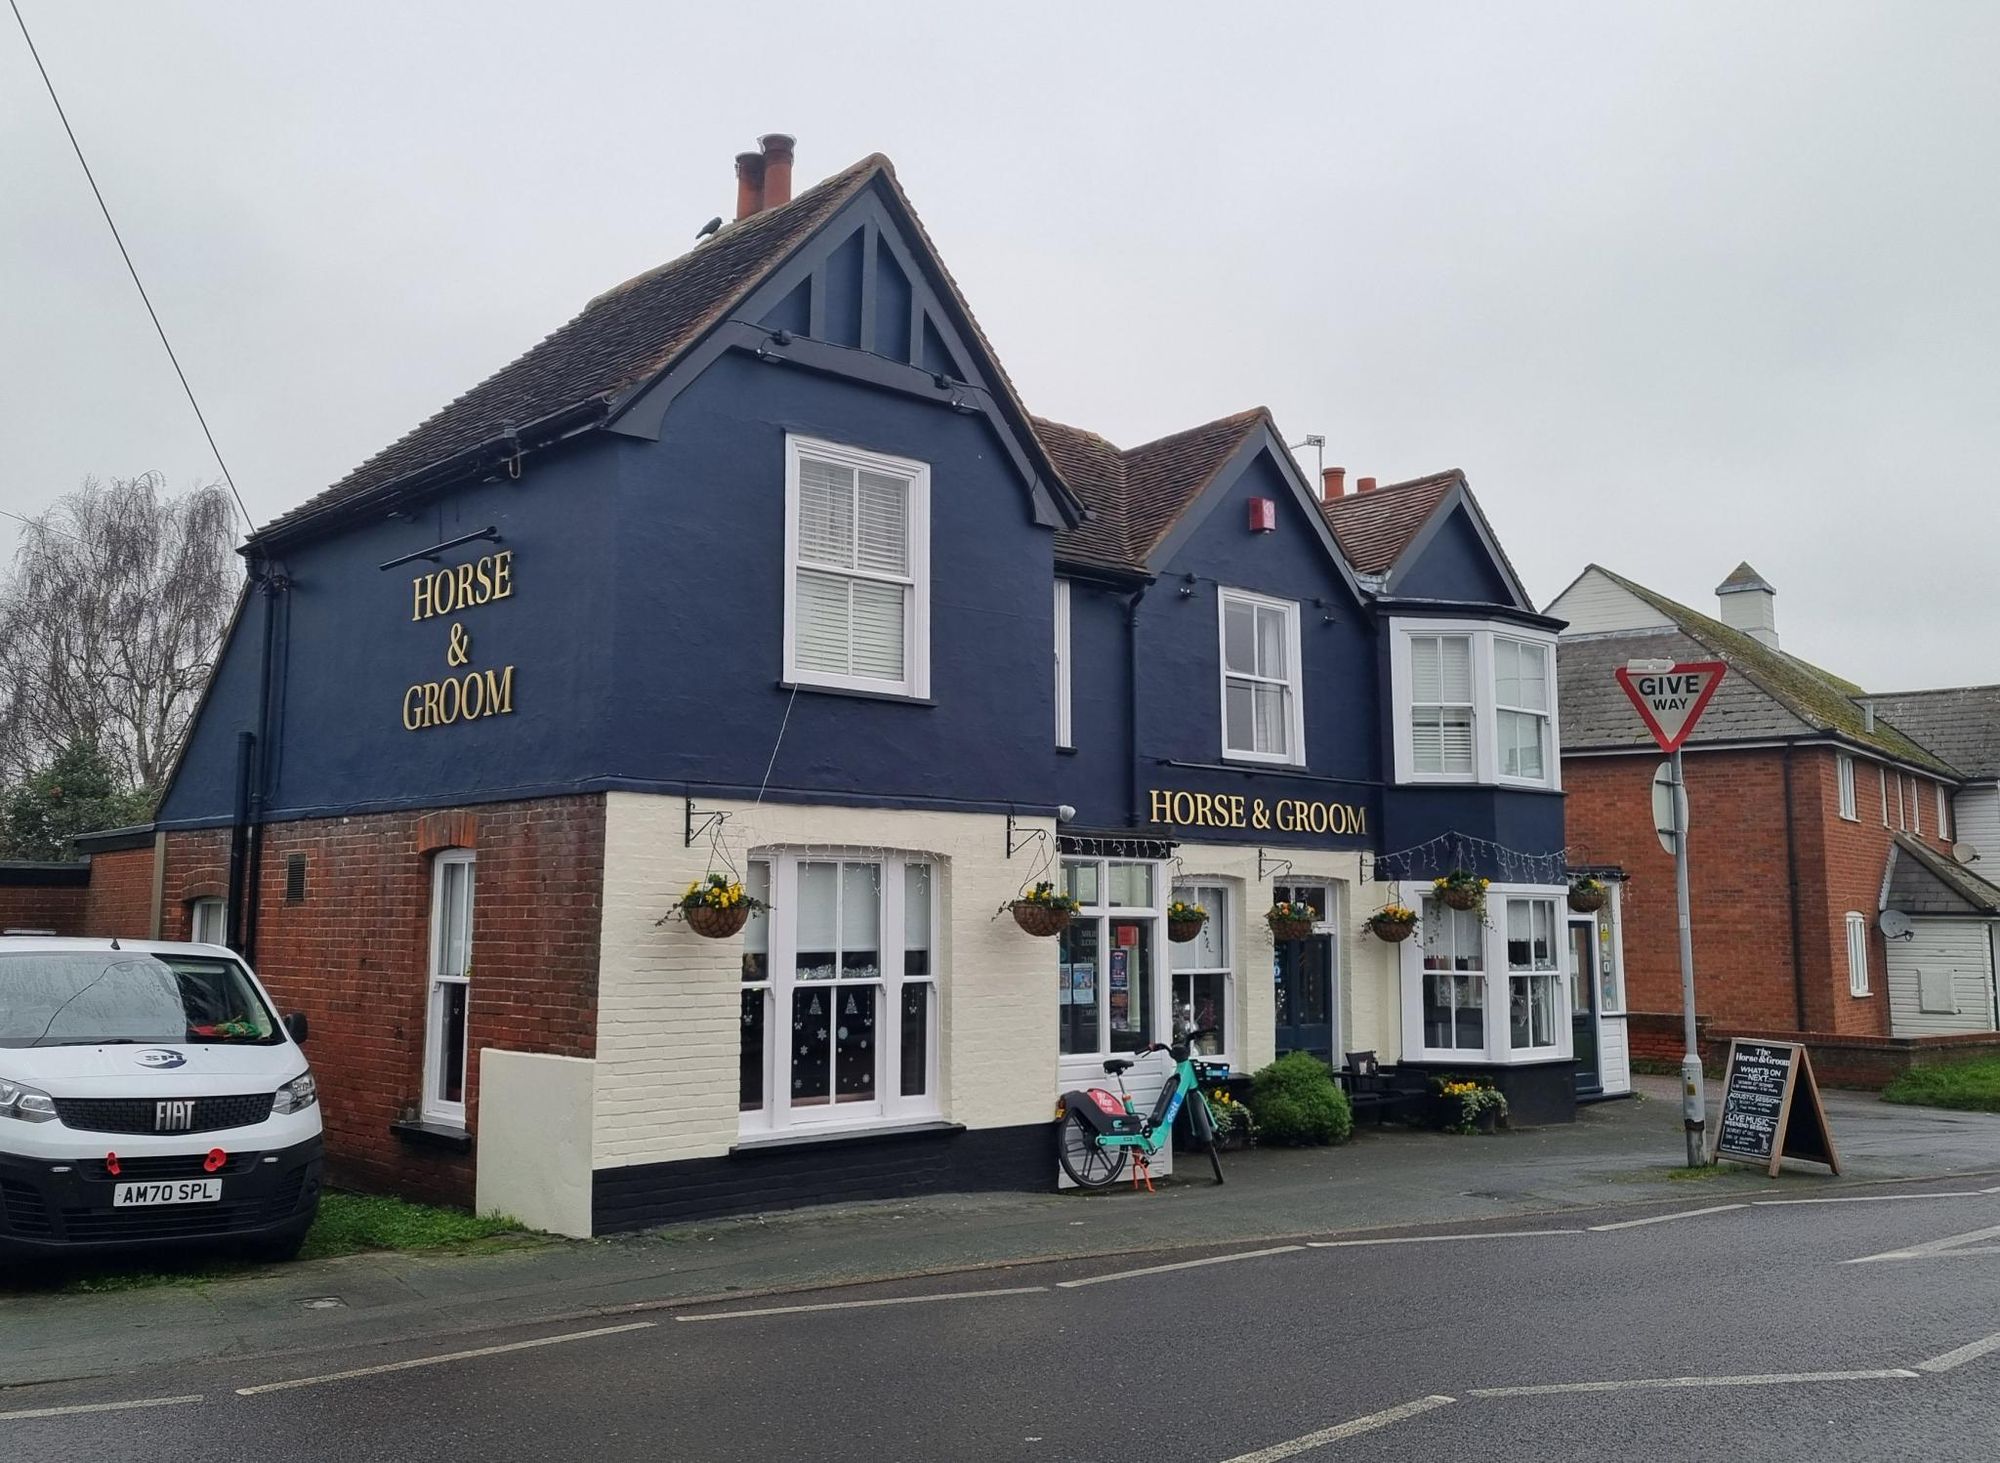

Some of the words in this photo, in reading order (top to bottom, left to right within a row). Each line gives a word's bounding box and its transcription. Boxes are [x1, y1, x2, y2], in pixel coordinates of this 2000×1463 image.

[412, 551, 513, 621] HORSE
[447, 622, 469, 667] &
[1639, 675, 1700, 696] GIVE
[403, 665, 514, 731] GROOM
[1653, 698, 1688, 711] WAY
[1149, 789, 1247, 828] HORSE
[1252, 798, 1271, 830] &
[1276, 799, 1369, 835] GROOM
[1736, 1052, 1758, 1063] Horse
[1755, 1047, 1771, 1056] The
[1740, 1065, 1769, 1076] WHAT'S
[1769, 1068, 1782, 1078] ON
[155, 1101, 195, 1131] FIAT
[1728, 1113, 1745, 1123] LIVE
[1745, 1115, 1770, 1127] MUSIC
[123, 1185, 172, 1204] AM70
[178, 1182, 213, 1201] SPL
